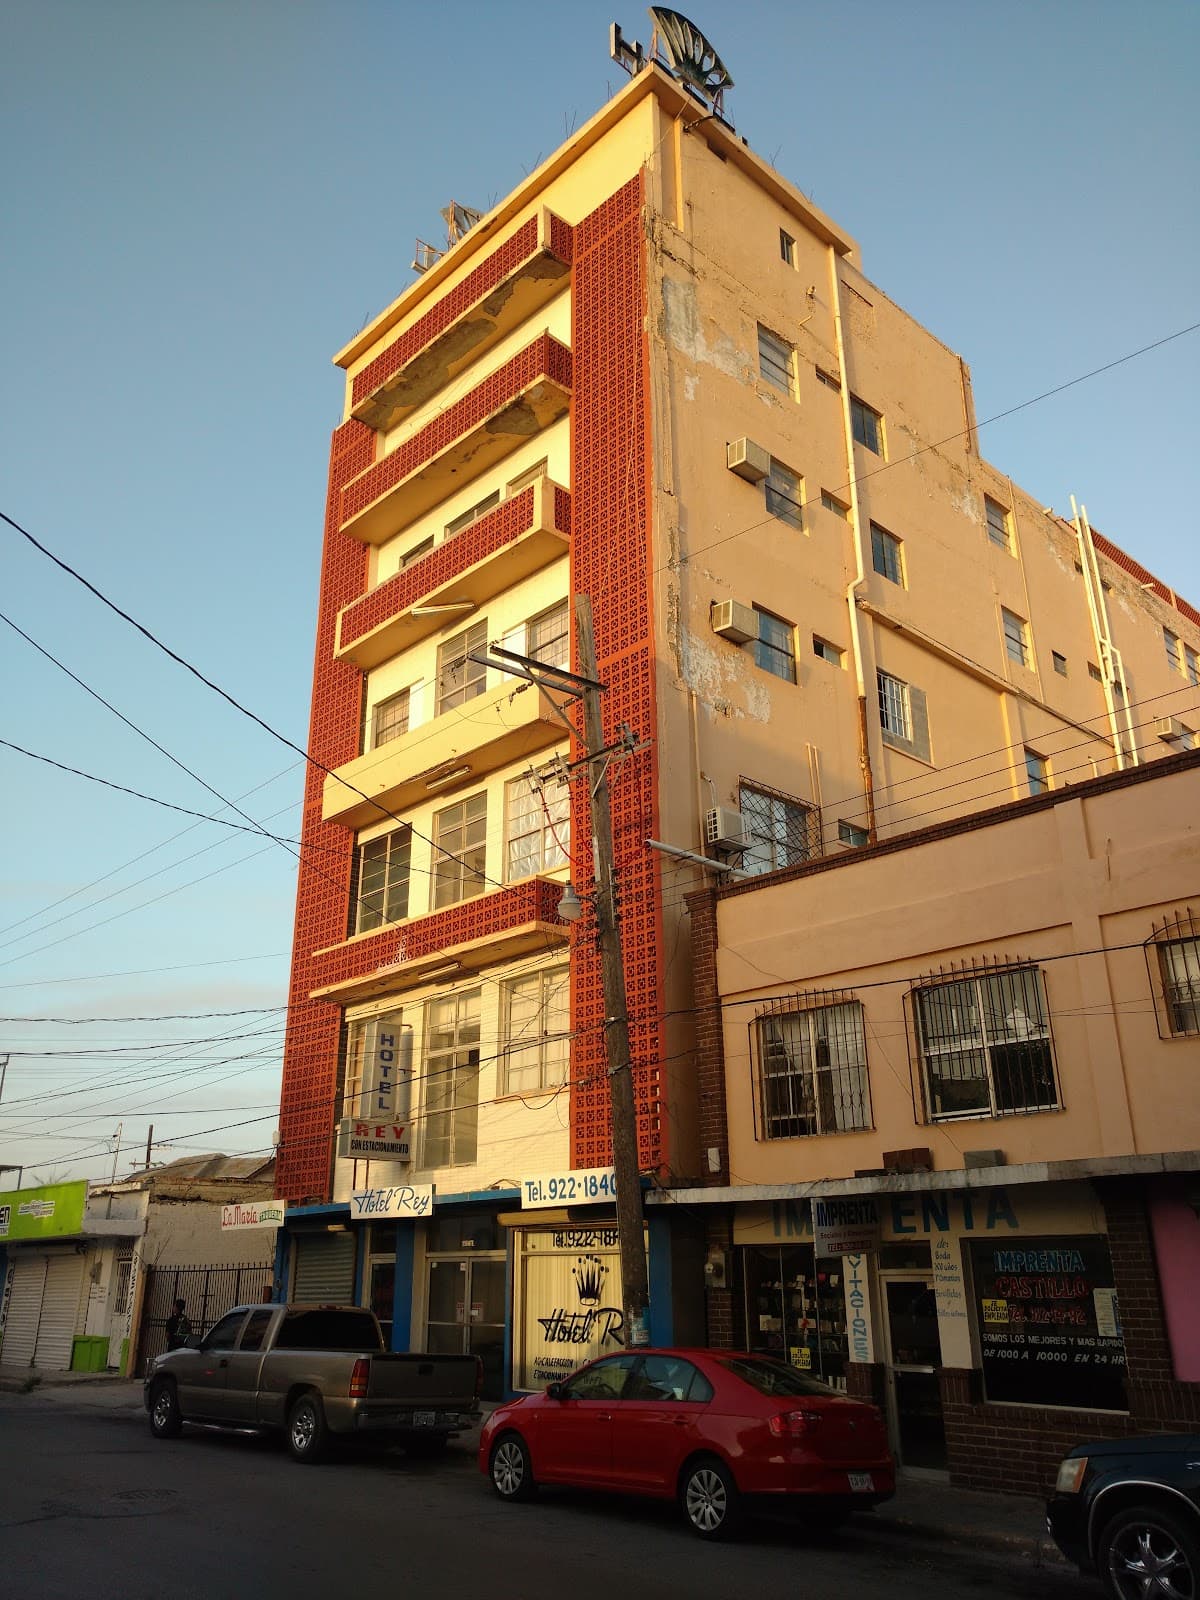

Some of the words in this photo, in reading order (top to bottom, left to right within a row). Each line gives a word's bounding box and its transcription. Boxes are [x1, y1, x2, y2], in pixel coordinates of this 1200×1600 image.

[378, 1033, 394, 1110] HOTEL
[355, 1122, 405, 1140] REY
[353, 1188, 393, 1213] Hotel
[394, 1186, 430, 1215] Rey
[769, 1187, 1020, 1237] IMENTA
[222, 1207, 233, 1227] La
[816, 1200, 879, 1227] IMPRENTA
[993, 1249, 1087, 1273] IMPRENTA
[996, 1276, 1090, 1300] CASTILLO
[848, 1253, 869, 1362] NVITACIONES
[537, 1310, 593, 1344] Hotel
[982, 1334, 1008, 1343] SOMOS
[1009, 1335, 1025, 1344] LOS
[1027, 1336, 1067, 1345] MEJORES
[1068, 1336, 1075, 1345] Y
[1077, 1337, 1095, 1346] MAS
[983, 1349, 996, 1357] DE
[997, 1350, 1019, 1359] 1000
[1021, 1351, 1029, 1360] A
[1074, 1354, 1090, 1363] EN
[1094, 1354, 1107, 1364] 24
